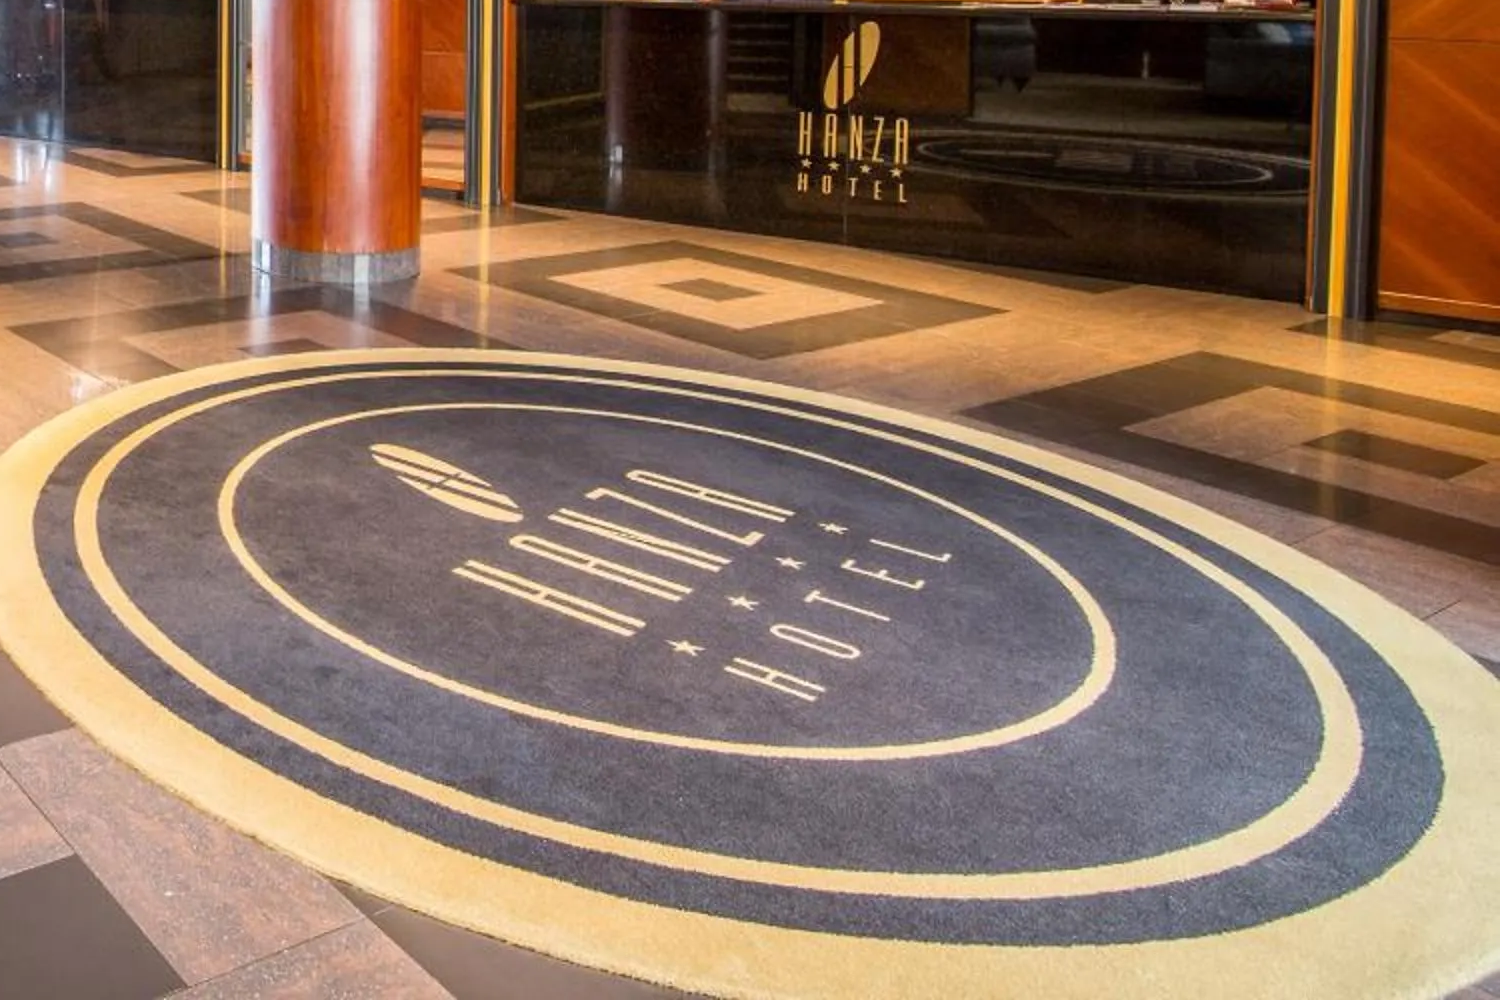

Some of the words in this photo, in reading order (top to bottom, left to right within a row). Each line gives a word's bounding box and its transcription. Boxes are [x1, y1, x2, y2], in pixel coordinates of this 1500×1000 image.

[797, 172, 907, 203] HOTEL
[798, 111, 909, 165] HANZA
[452, 470, 795, 637] HANZA
[723, 538, 953, 701] HOTEL
